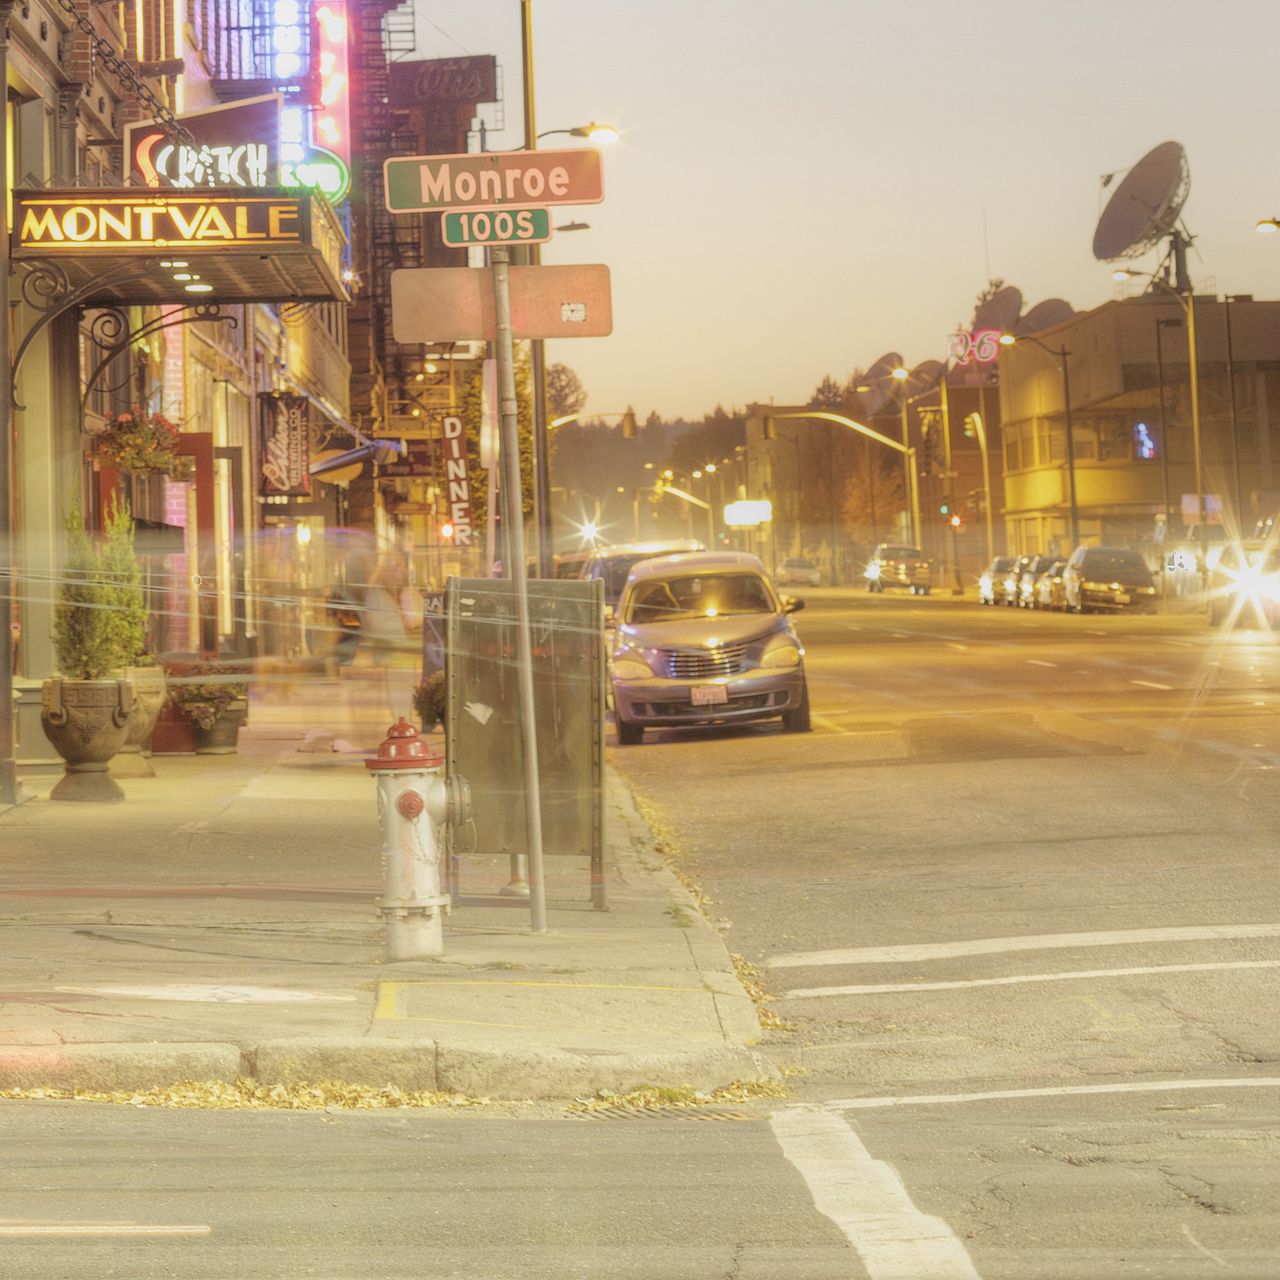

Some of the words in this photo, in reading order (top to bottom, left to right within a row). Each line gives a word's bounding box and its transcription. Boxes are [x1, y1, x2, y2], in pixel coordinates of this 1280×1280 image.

[419, 163, 570, 203] Monroe
[20, 205, 300, 241] MONTVALE
[442, 415, 473, 547] DINNER
